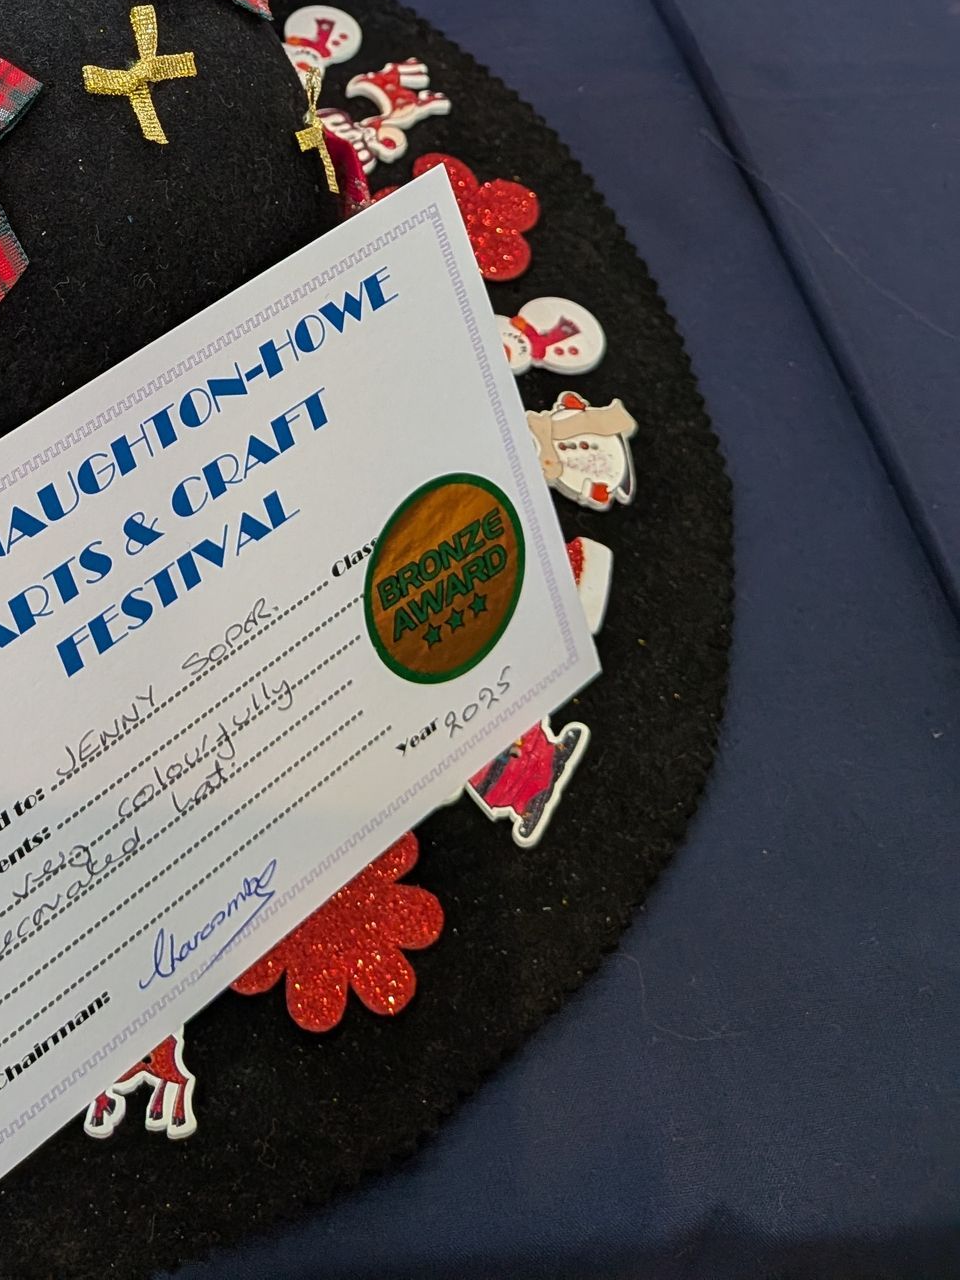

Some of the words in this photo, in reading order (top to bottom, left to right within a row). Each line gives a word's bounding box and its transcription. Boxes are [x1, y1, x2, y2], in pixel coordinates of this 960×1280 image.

[122, 511, 166, 556] &
[171, 387, 329, 518] CRAFT
[56, 490, 301, 679] FESTIVAL
[376, 507, 505, 612] BRONZE
[391, 543, 508, 643] AWARD
[55, 684, 157, 777] JENNY
[118, 679, 293, 818] colourfully
[395, 716, 440, 758] Year
[444, 665, 512, 739] 2025
[12, 787, 46, 818] to:
